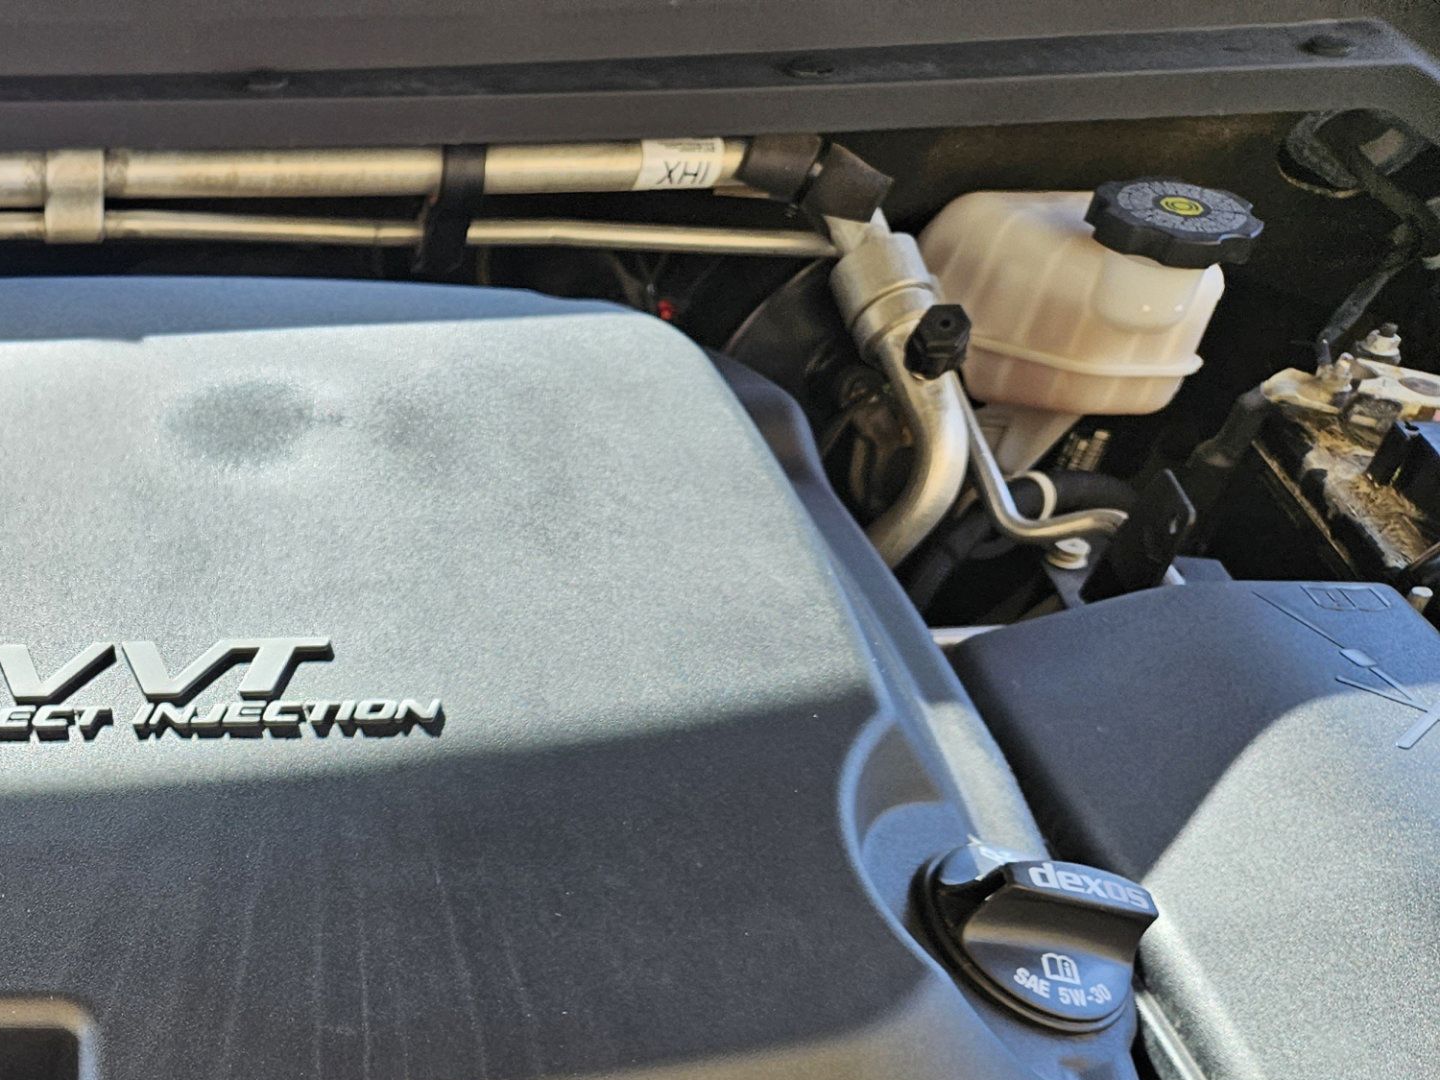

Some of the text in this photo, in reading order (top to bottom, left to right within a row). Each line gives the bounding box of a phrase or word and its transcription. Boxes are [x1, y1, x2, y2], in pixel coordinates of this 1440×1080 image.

[128, 698, 445, 740] INJECTION
[1029, 863, 1149, 909] dexos
[1013, 967, 1112, 1007] SAE 5W-30
